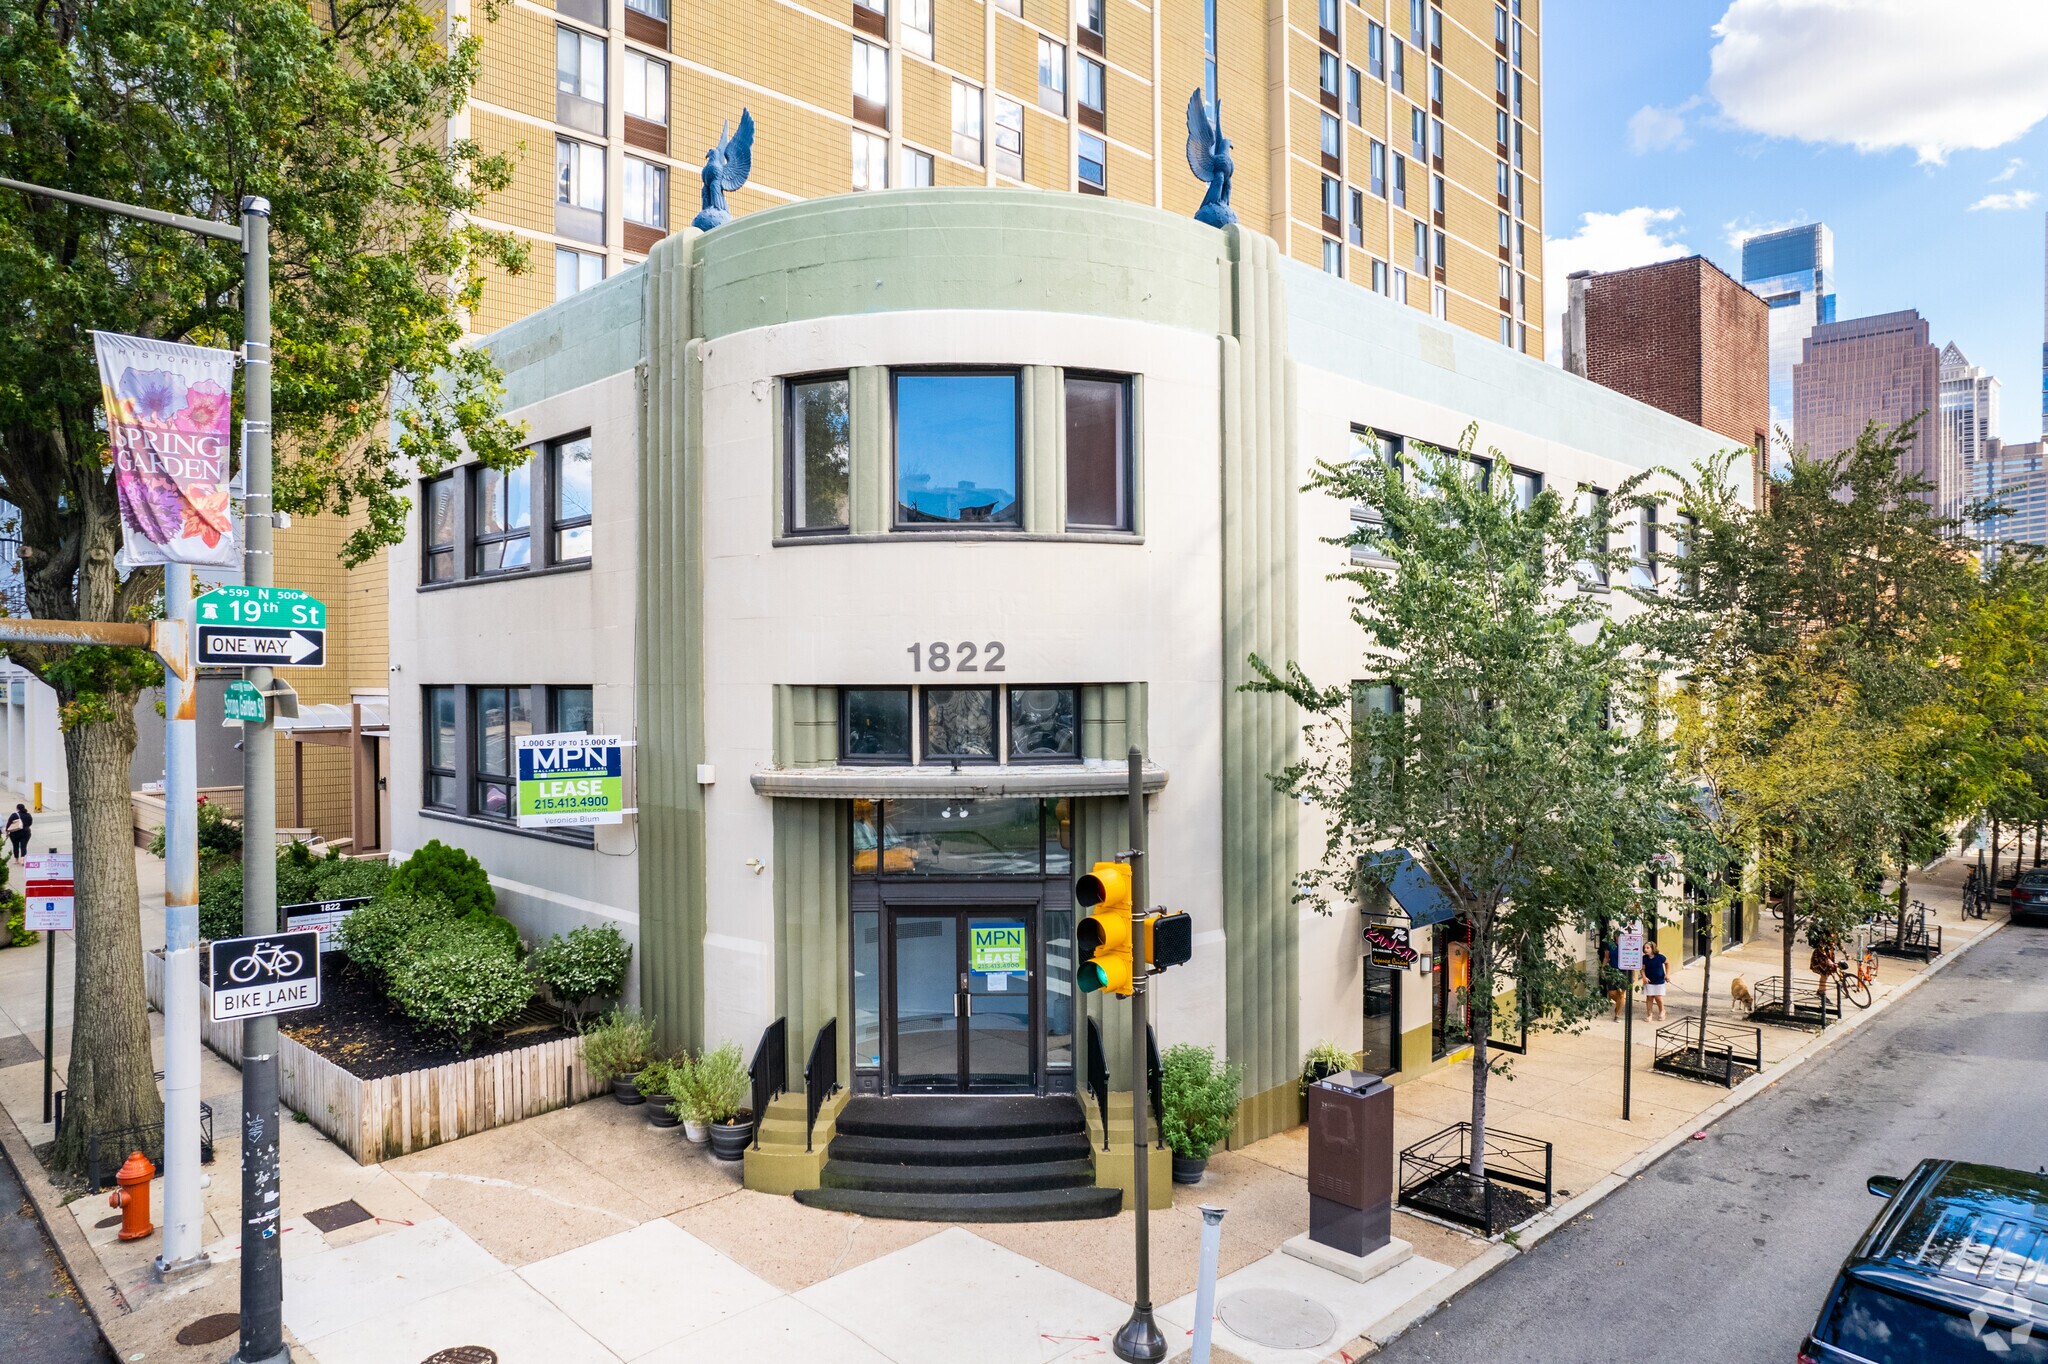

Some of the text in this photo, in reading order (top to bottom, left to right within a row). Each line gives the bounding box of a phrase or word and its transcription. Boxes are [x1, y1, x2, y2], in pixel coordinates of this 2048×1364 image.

[118, 348, 212, 368] HISTORIC
[116, 425, 221, 458] SPRING
[117, 450, 221, 480] GARDEN
[229, 588, 299, 600] 599 N 500
[229, 600, 319, 625] 19th St
[213, 637, 288, 653] ONE WAY
[907, 641, 1006, 672] 1822
[239, 694, 258, 717] Garden
[257, 698, 265, 718] St
[546, 739, 556, 747] SF
[608, 738, 618, 746] SF
[533, 747, 608, 769] MPN
[539, 779, 603, 798] LEASE
[534, 796, 609, 810] 215.413.4900
[544, 815, 600, 825] Veronica Blum
[320, 902, 341, 912] 1822
[976, 930, 1021, 945] MPN
[1365, 929, 1418, 962] KANSAI
[977, 953, 1020, 964] LEASE
[225, 985, 308, 1011] BIKE LANE
